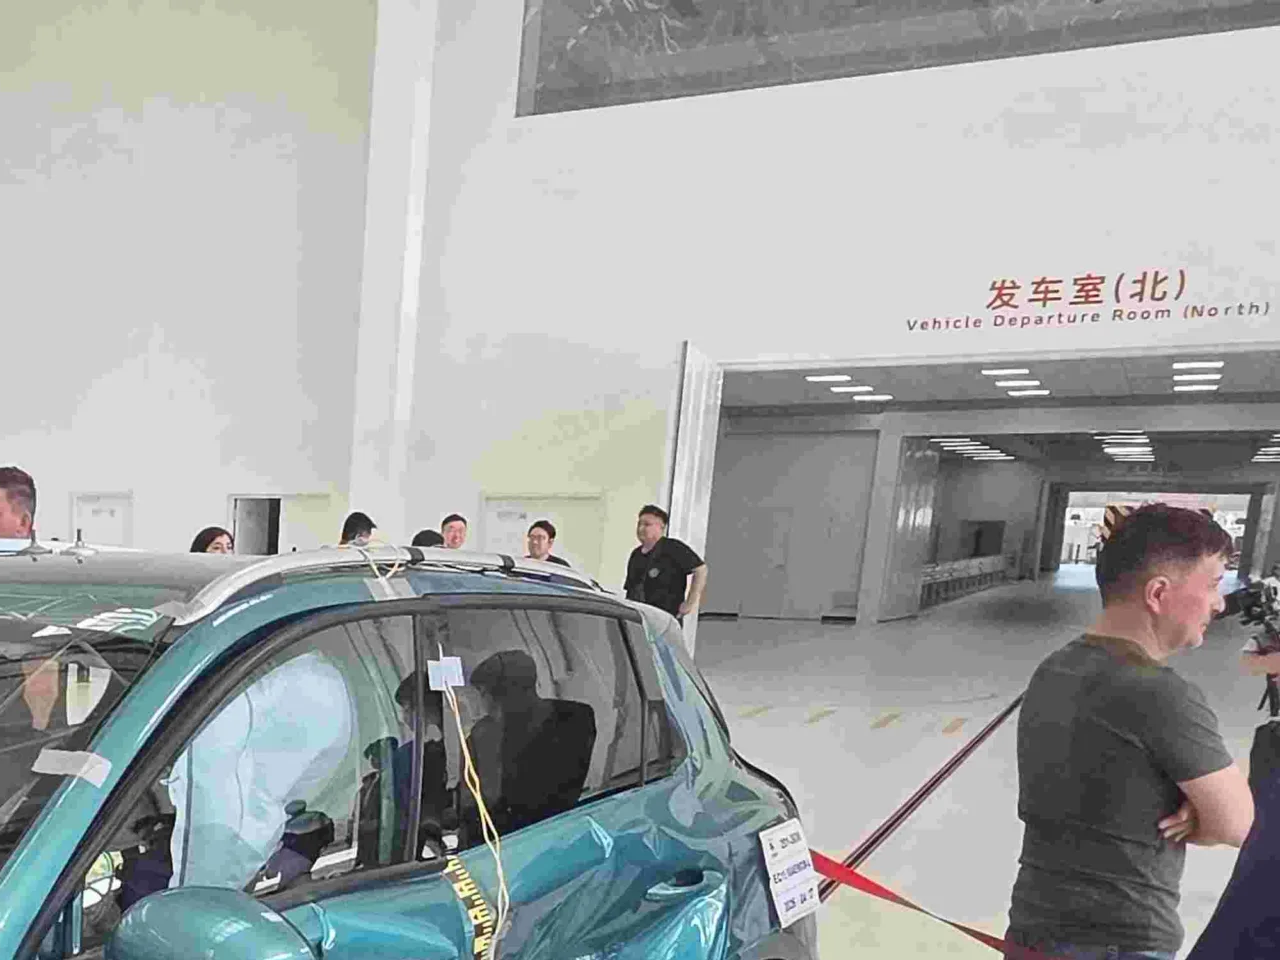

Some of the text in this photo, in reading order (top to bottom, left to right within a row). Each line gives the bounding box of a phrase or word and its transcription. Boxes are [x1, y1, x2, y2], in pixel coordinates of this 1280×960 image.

[986, 269, 1187, 310] 发车室(北)
[906, 301, 1270, 331] Vehicle Departure Room (North)
